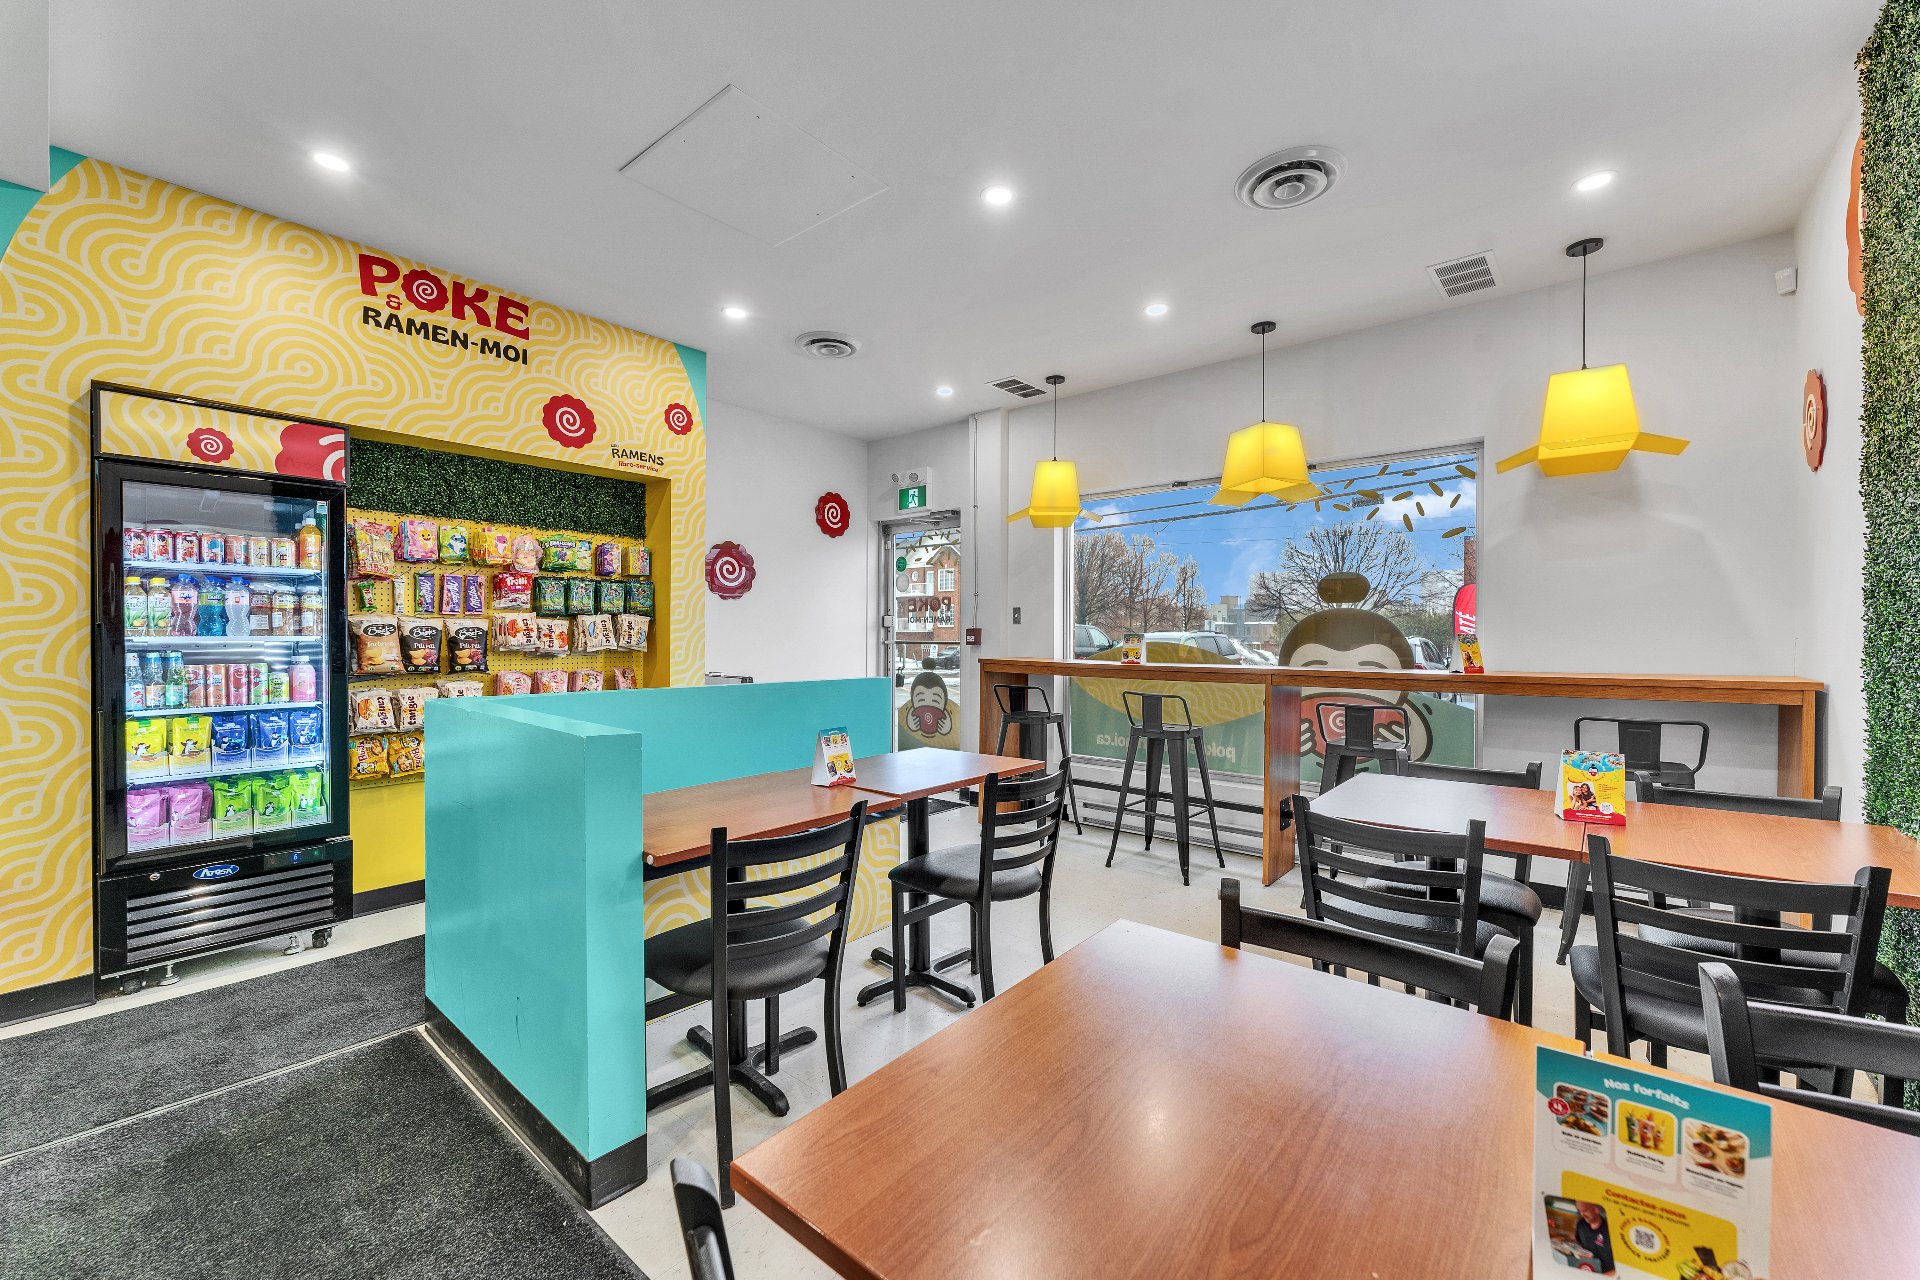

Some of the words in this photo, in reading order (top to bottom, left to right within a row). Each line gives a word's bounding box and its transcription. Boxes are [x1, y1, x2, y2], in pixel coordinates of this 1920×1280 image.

[358, 253, 530, 341] POKE
[385, 293, 403, 311] &
[362, 305, 528, 366] RAMEN-MOI
[611, 448, 665, 467] RAMENS
[1603, 1078, 1632, 1092] Nos
[1634, 1083, 1690, 1110] forfaits
